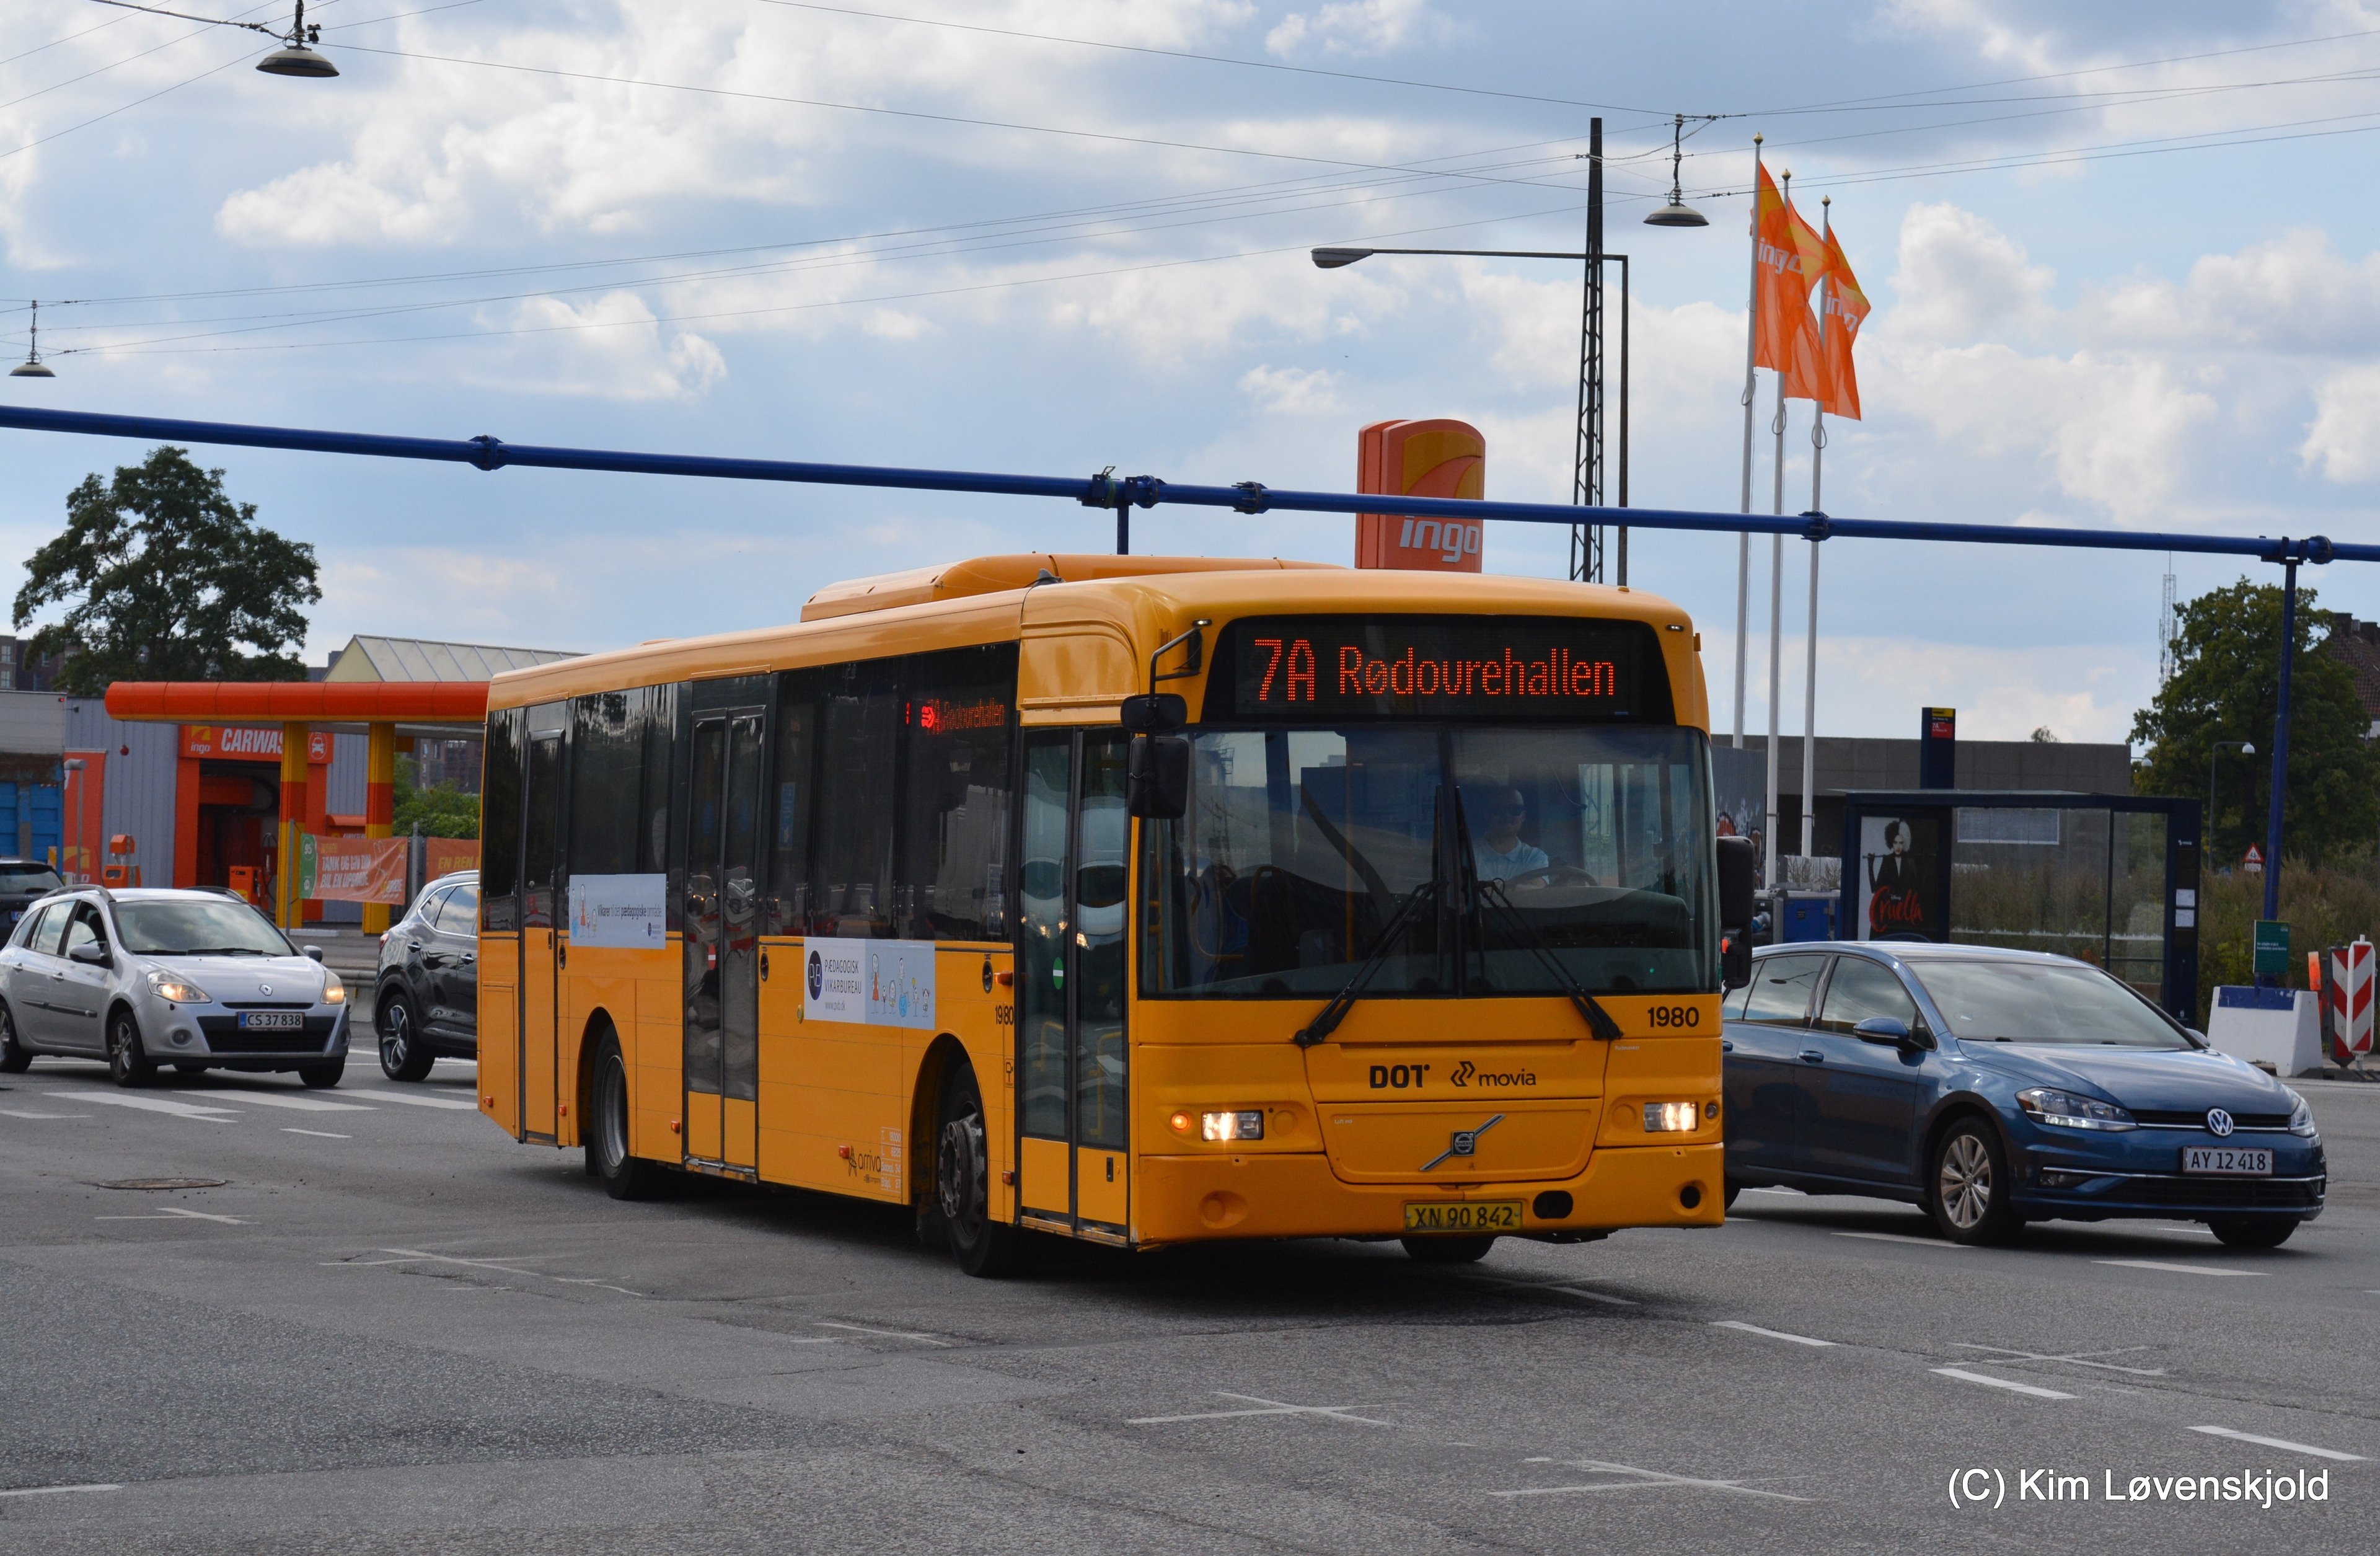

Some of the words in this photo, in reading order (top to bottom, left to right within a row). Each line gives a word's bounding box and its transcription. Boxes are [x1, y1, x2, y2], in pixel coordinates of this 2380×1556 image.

[1399, 516, 1479, 563] ingo
[1254, 639, 1315, 701] 7A
[191, 742, 211, 754] ingo
[320, 873, 332, 888] BIL
[1869, 885, 1924, 932] Cruella
[825, 960, 859, 973] PÆDAGOGISK
[825, 979, 862, 994] VIKARBUREAU
[248, 1014, 262, 1026] CS
[265, 1014, 278, 1026] 37
[281, 1015, 301, 1026] 838
[995, 1005, 1014, 1025] 1980
[1647, 1006, 1699, 1028] 1980
[1478, 1068, 1536, 1086] movia
[858, 1150, 881, 1173] arriva
[2191, 1152, 2211, 1169] AY
[2216, 1152, 2234, 1169] 12
[2238, 1153, 2266, 1170] 418
[1413, 1208, 1441, 1227] XN
[1448, 1207, 1471, 1227] 90
[1477, 1206, 1514, 1227] 842
